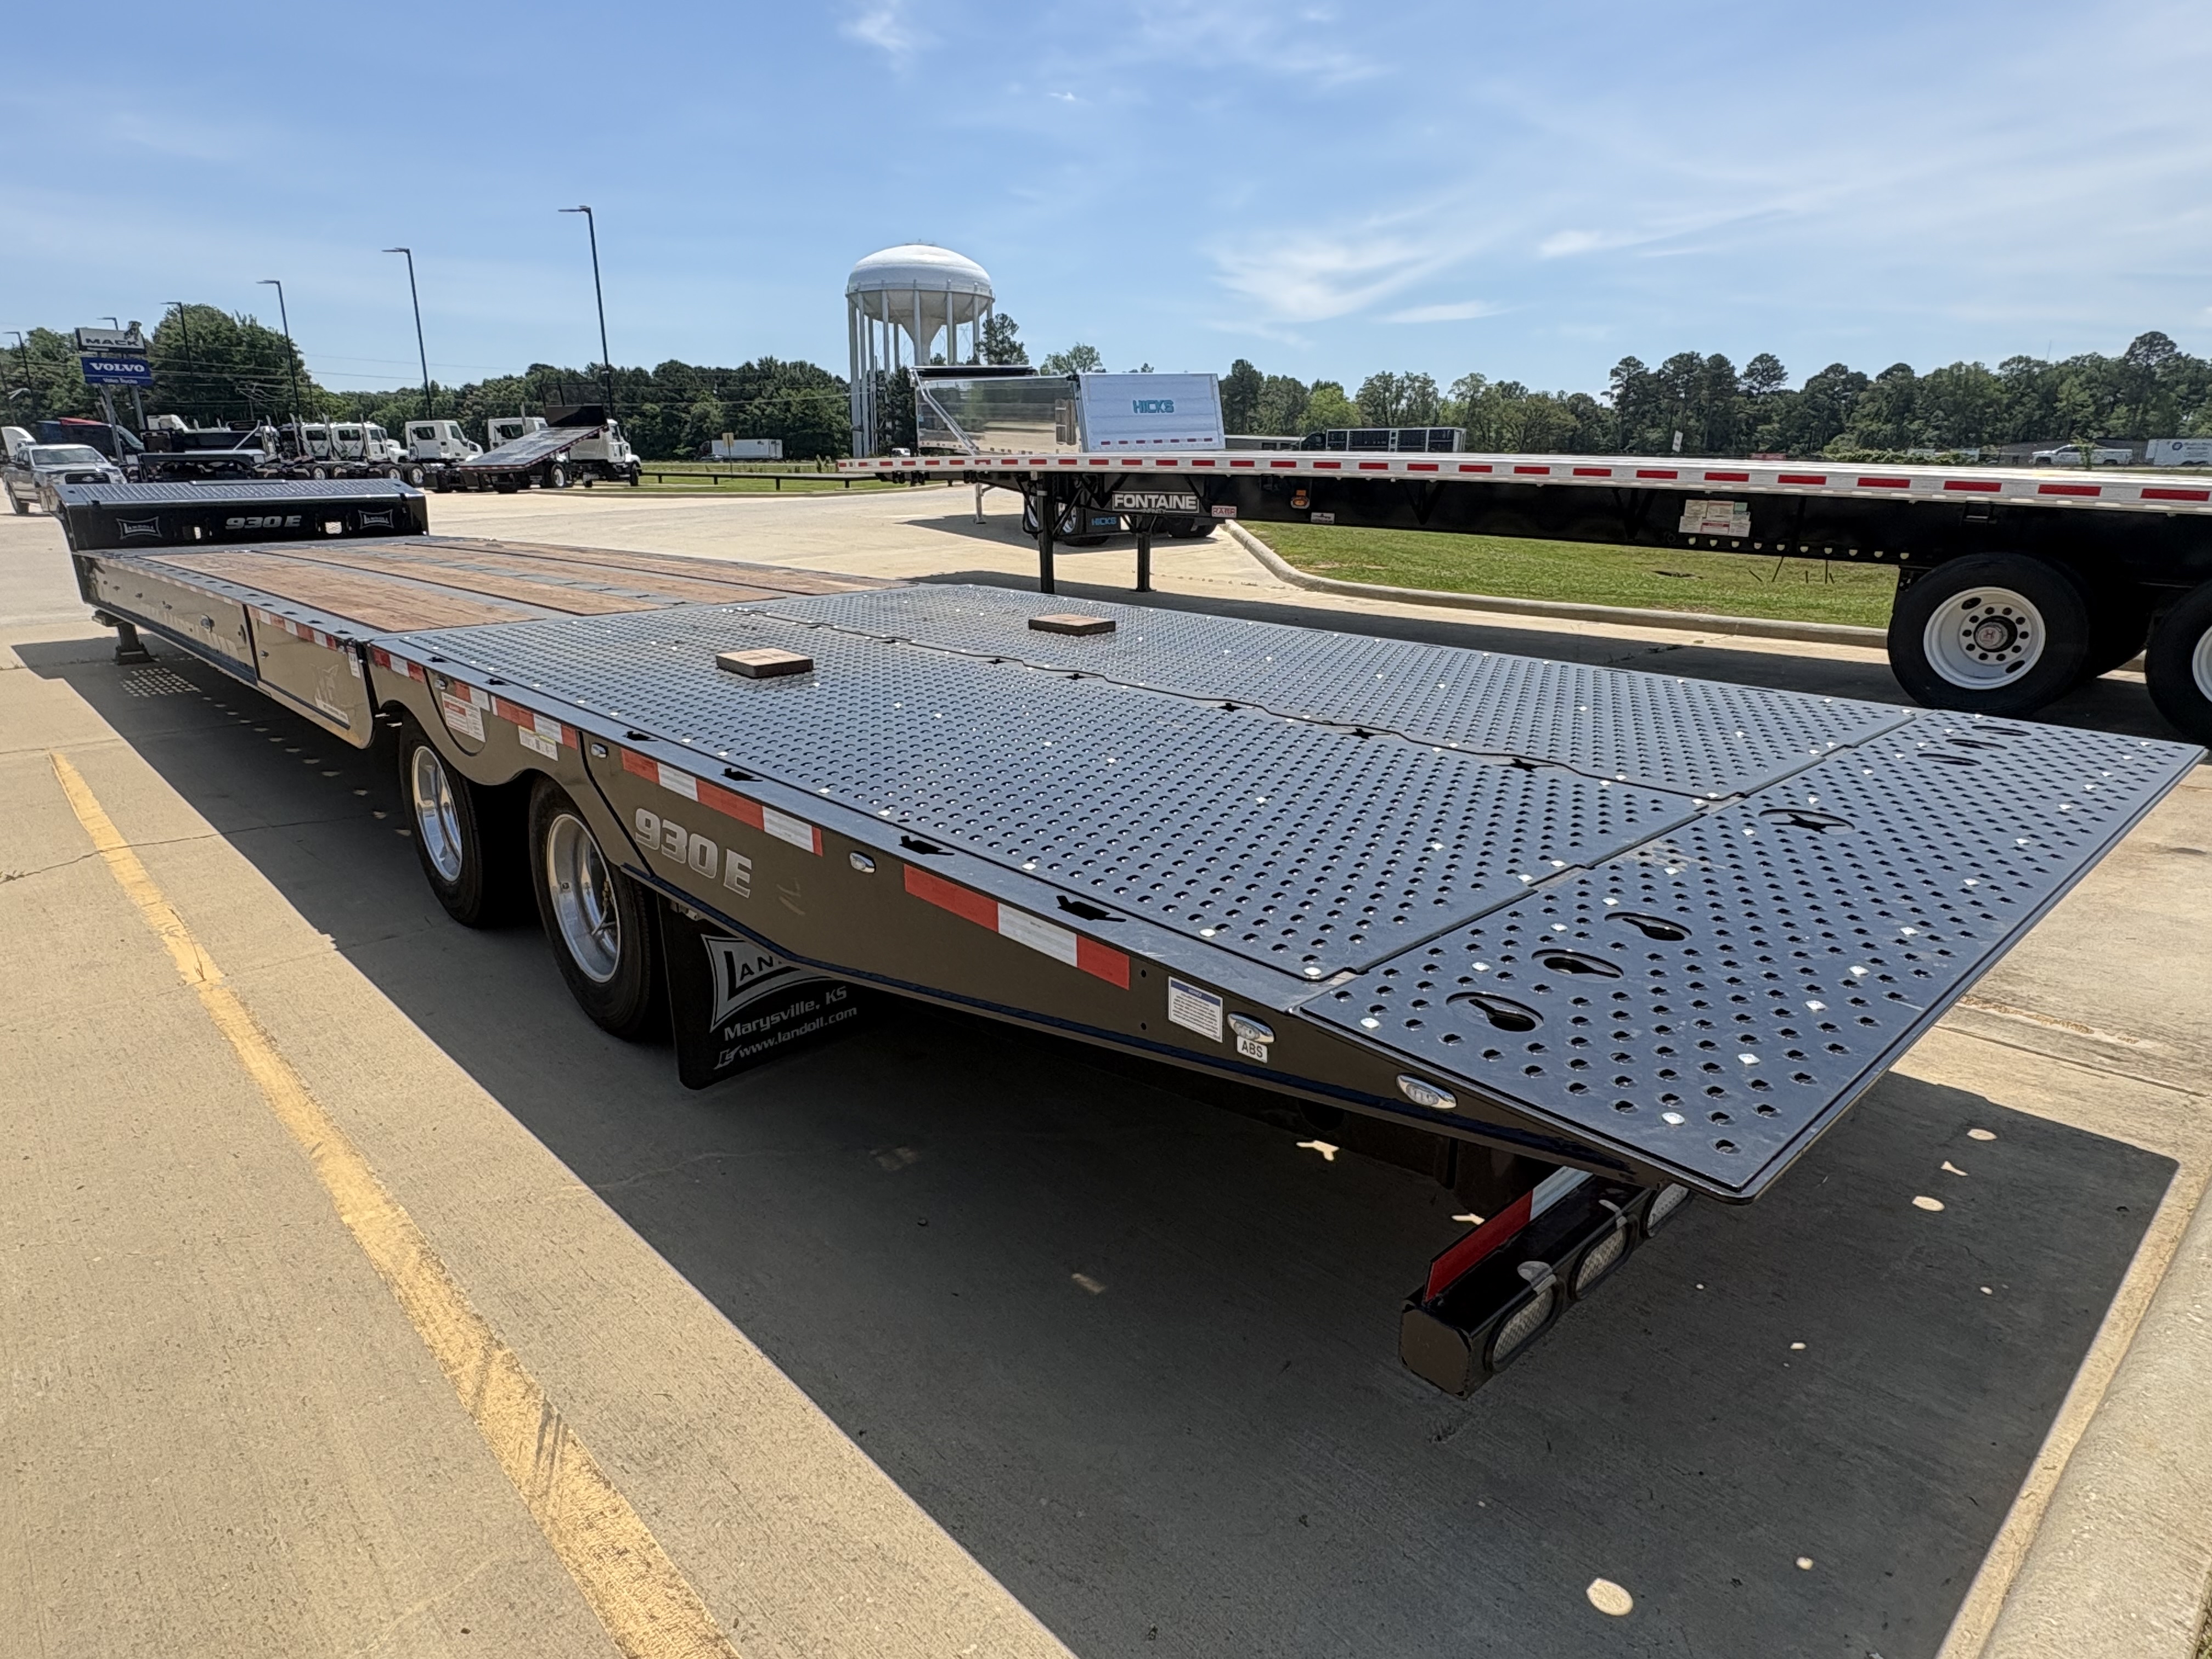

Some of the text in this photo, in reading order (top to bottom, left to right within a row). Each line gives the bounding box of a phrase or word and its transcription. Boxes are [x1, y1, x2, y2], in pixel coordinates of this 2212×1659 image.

[85, 338, 139, 346] MACK
[89, 363, 145, 372] VOLVO
[1132, 400, 1174, 414] HICKS
[1114, 494, 1198, 510] FONTAINE
[225, 515, 302, 529] 930 E
[1091, 517, 1116, 525] HICKS
[635, 808, 752, 899] 930 E
[723, 950, 800, 1002] LAN
[724, 986, 848, 1041] Marysville, KS
[739, 1007, 857, 1058] www.landoll.com
[1241, 1040, 1263, 1058] ABS
